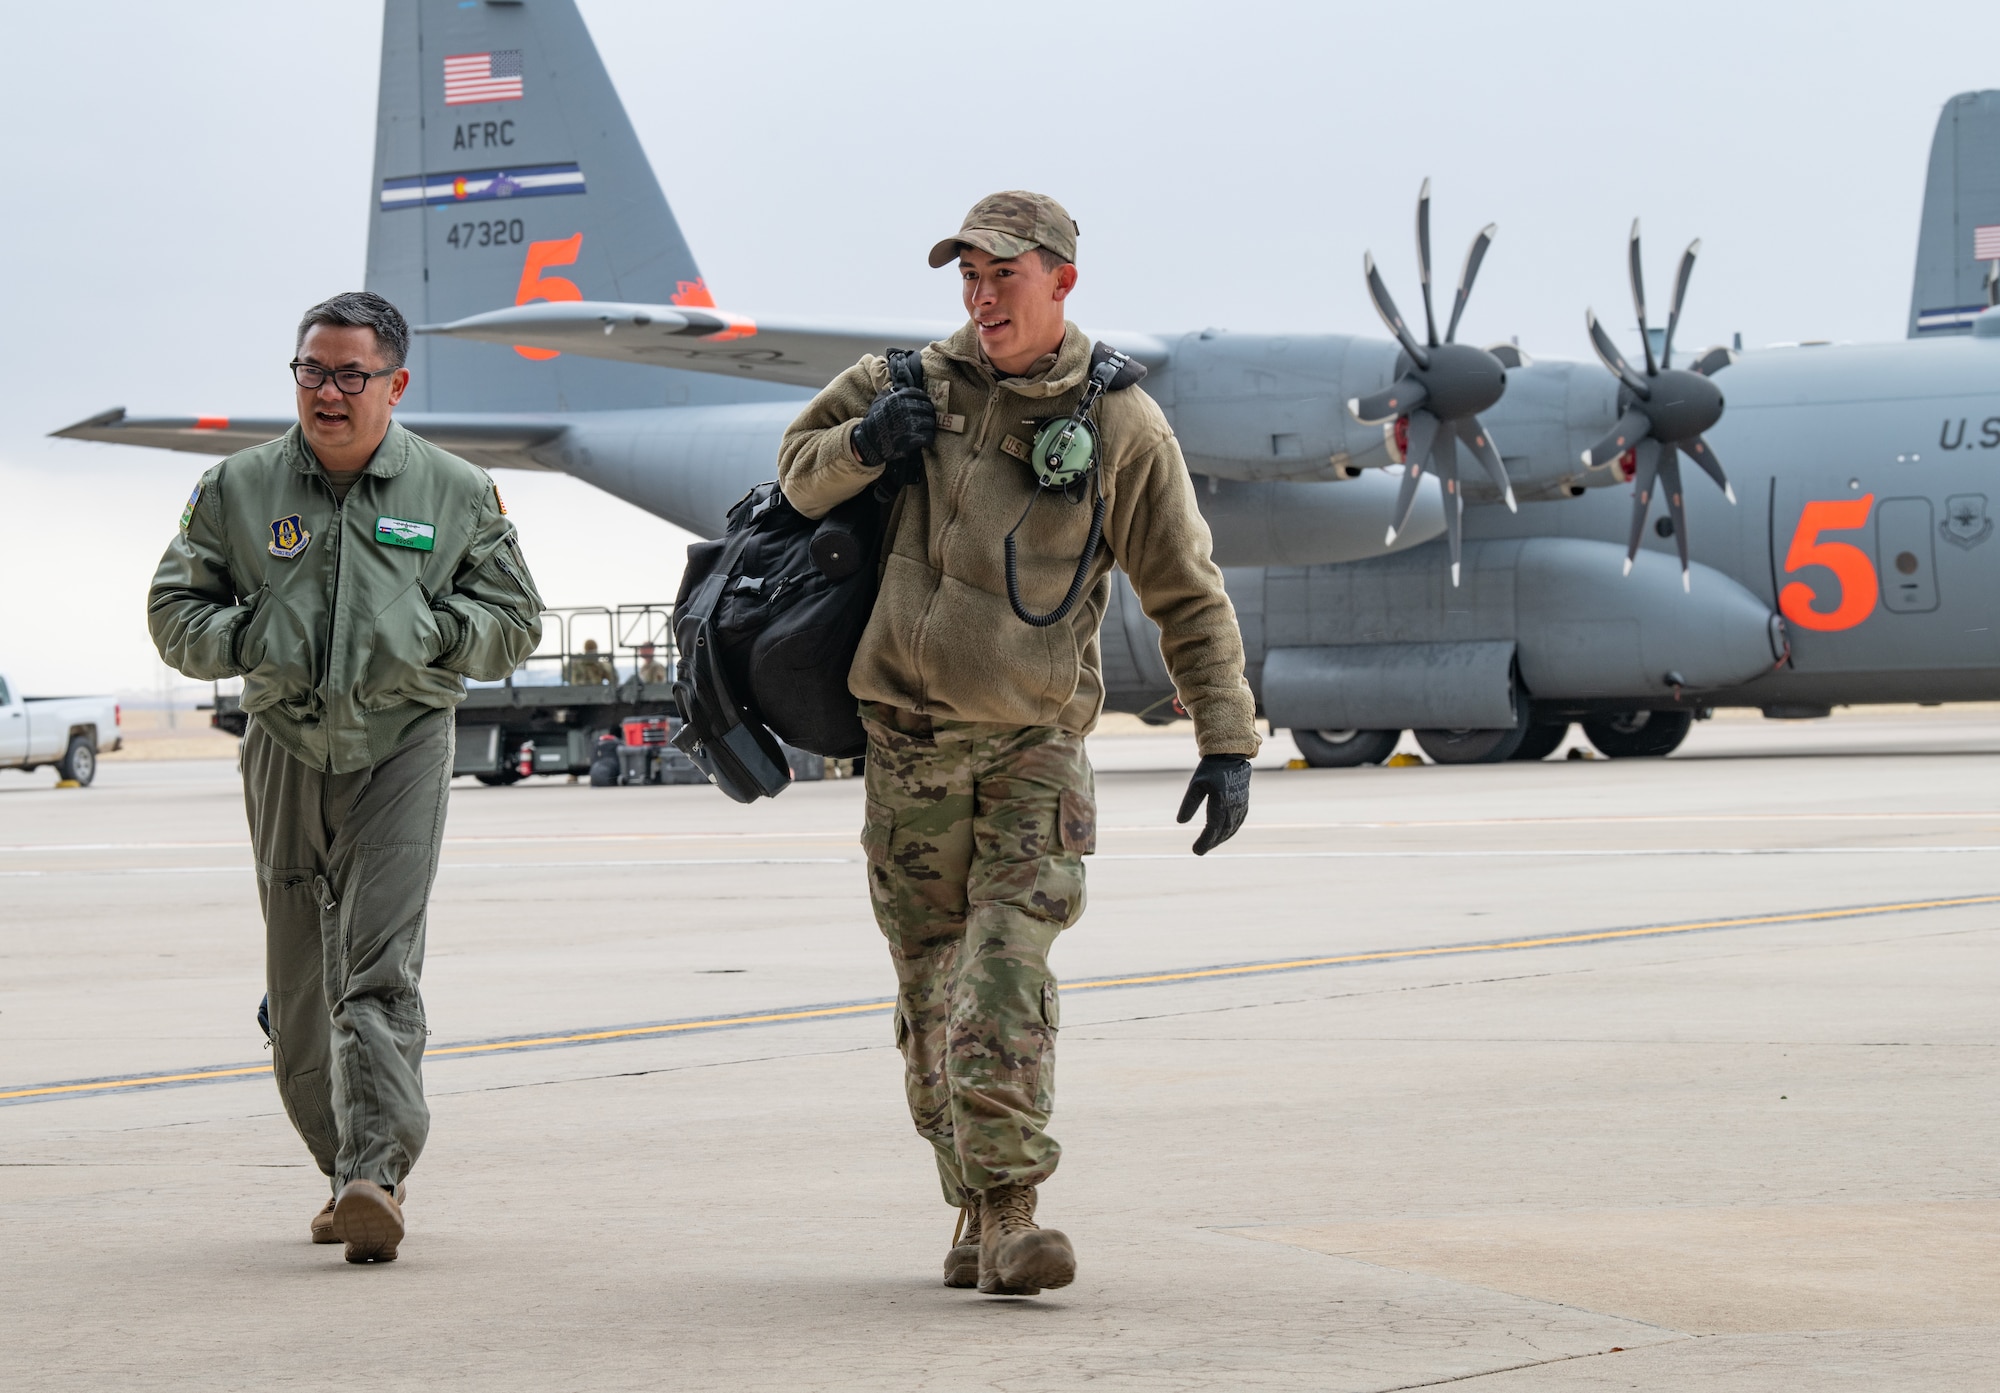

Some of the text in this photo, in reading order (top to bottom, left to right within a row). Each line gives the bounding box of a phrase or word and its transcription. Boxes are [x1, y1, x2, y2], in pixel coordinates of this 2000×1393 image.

[453, 120, 515, 151] AFRC
[447, 218, 524, 249] 47320
[1005, 437, 1023, 456] U.S.
[1778, 492, 1879, 632] 5
